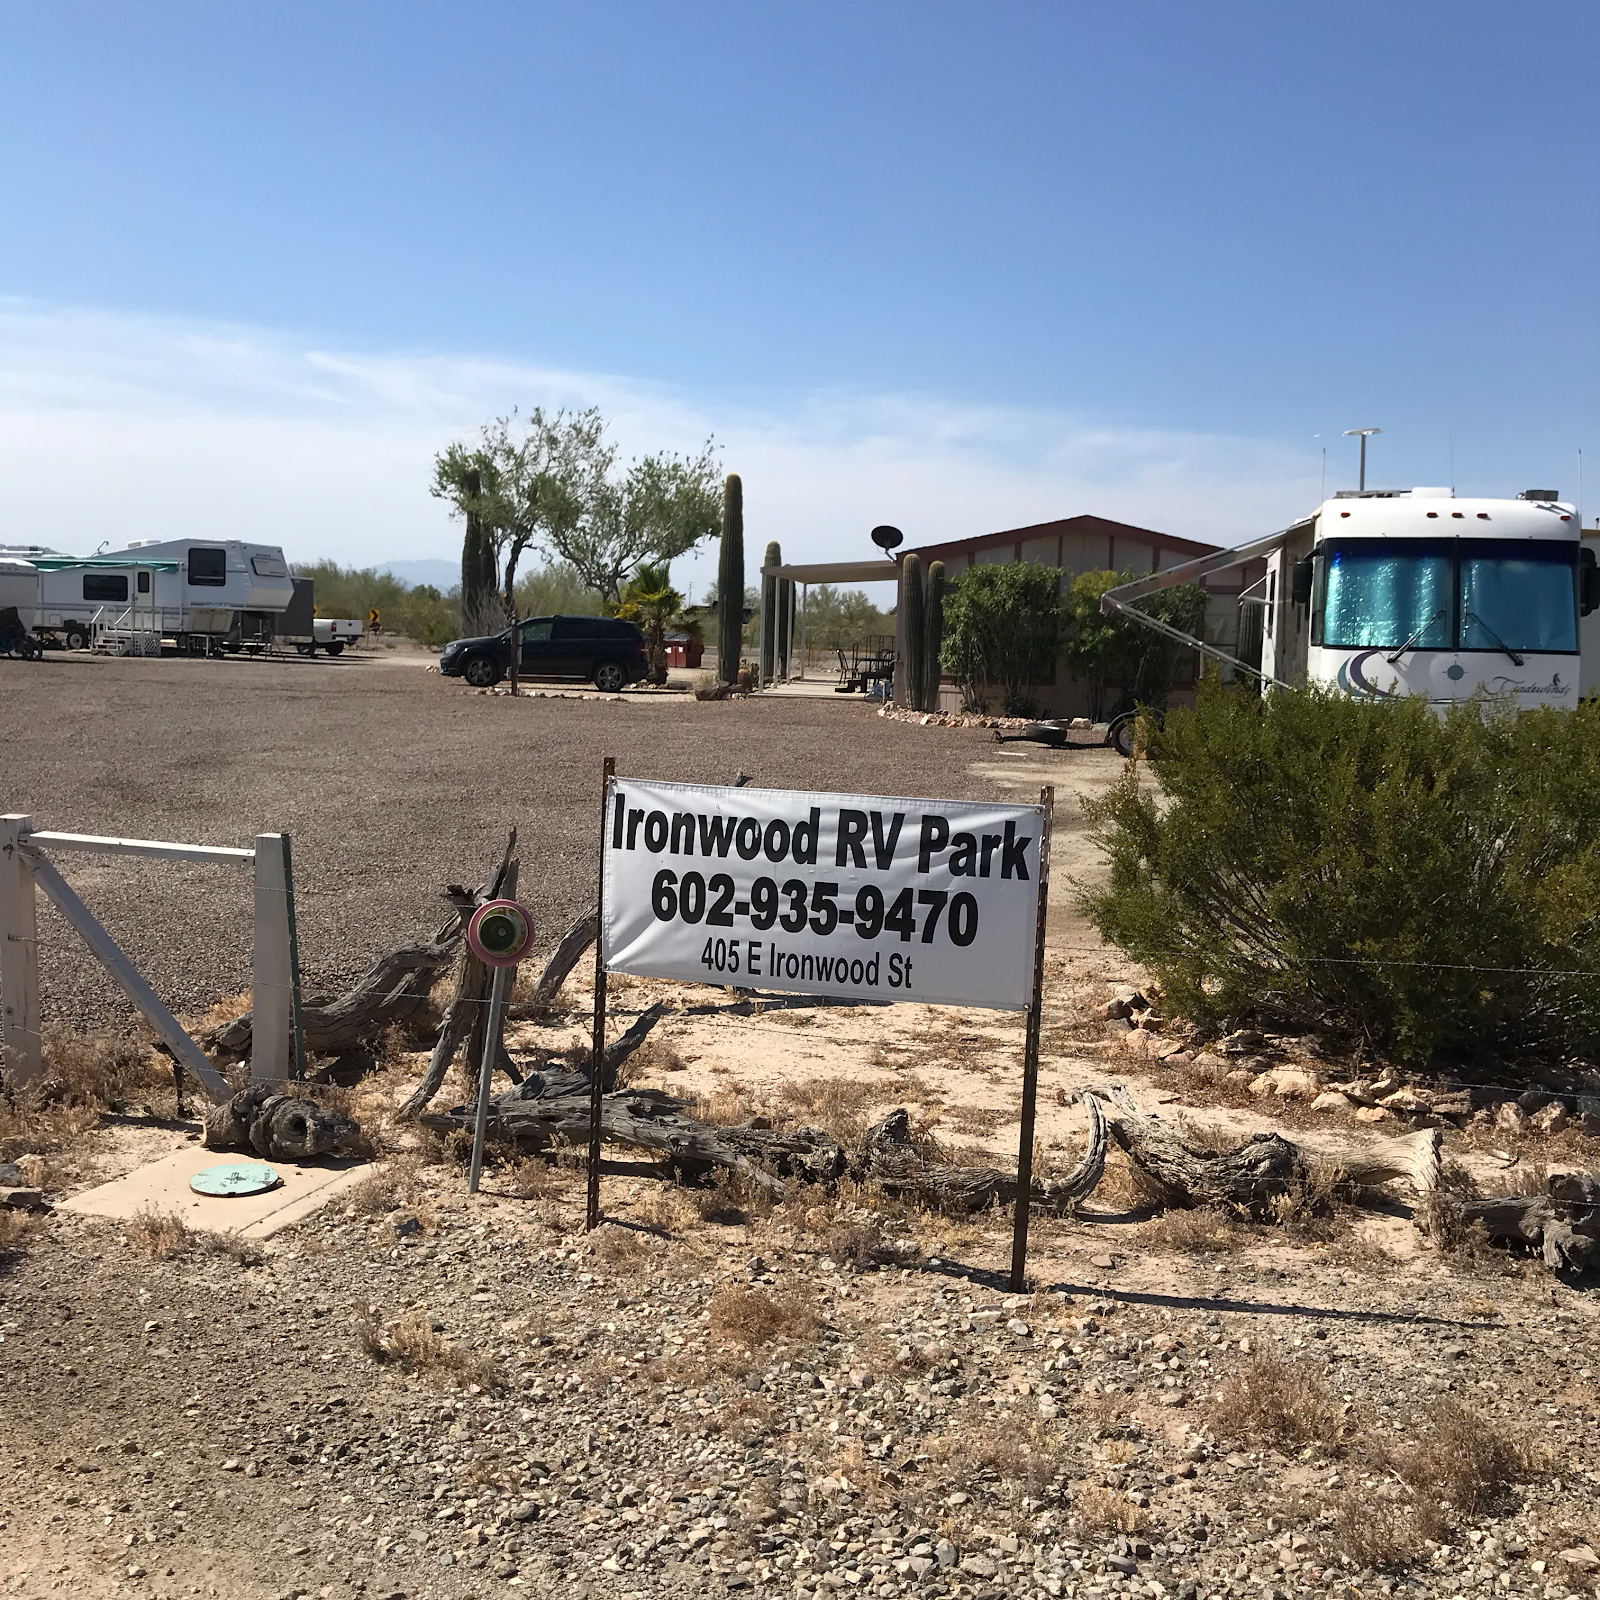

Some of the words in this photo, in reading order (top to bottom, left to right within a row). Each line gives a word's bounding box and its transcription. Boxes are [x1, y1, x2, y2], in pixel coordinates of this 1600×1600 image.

[612, 793, 820, 864] Ironwood
[836, 808, 905, 870] RV
[918, 815, 1031, 881] Park
[651, 869, 979, 947] 602-935-9470
[701, 937, 740, 972] 405
[747, 941, 762, 975] E
[770, 943, 880, 985] Ironwood
[888, 952, 913, 989] St
